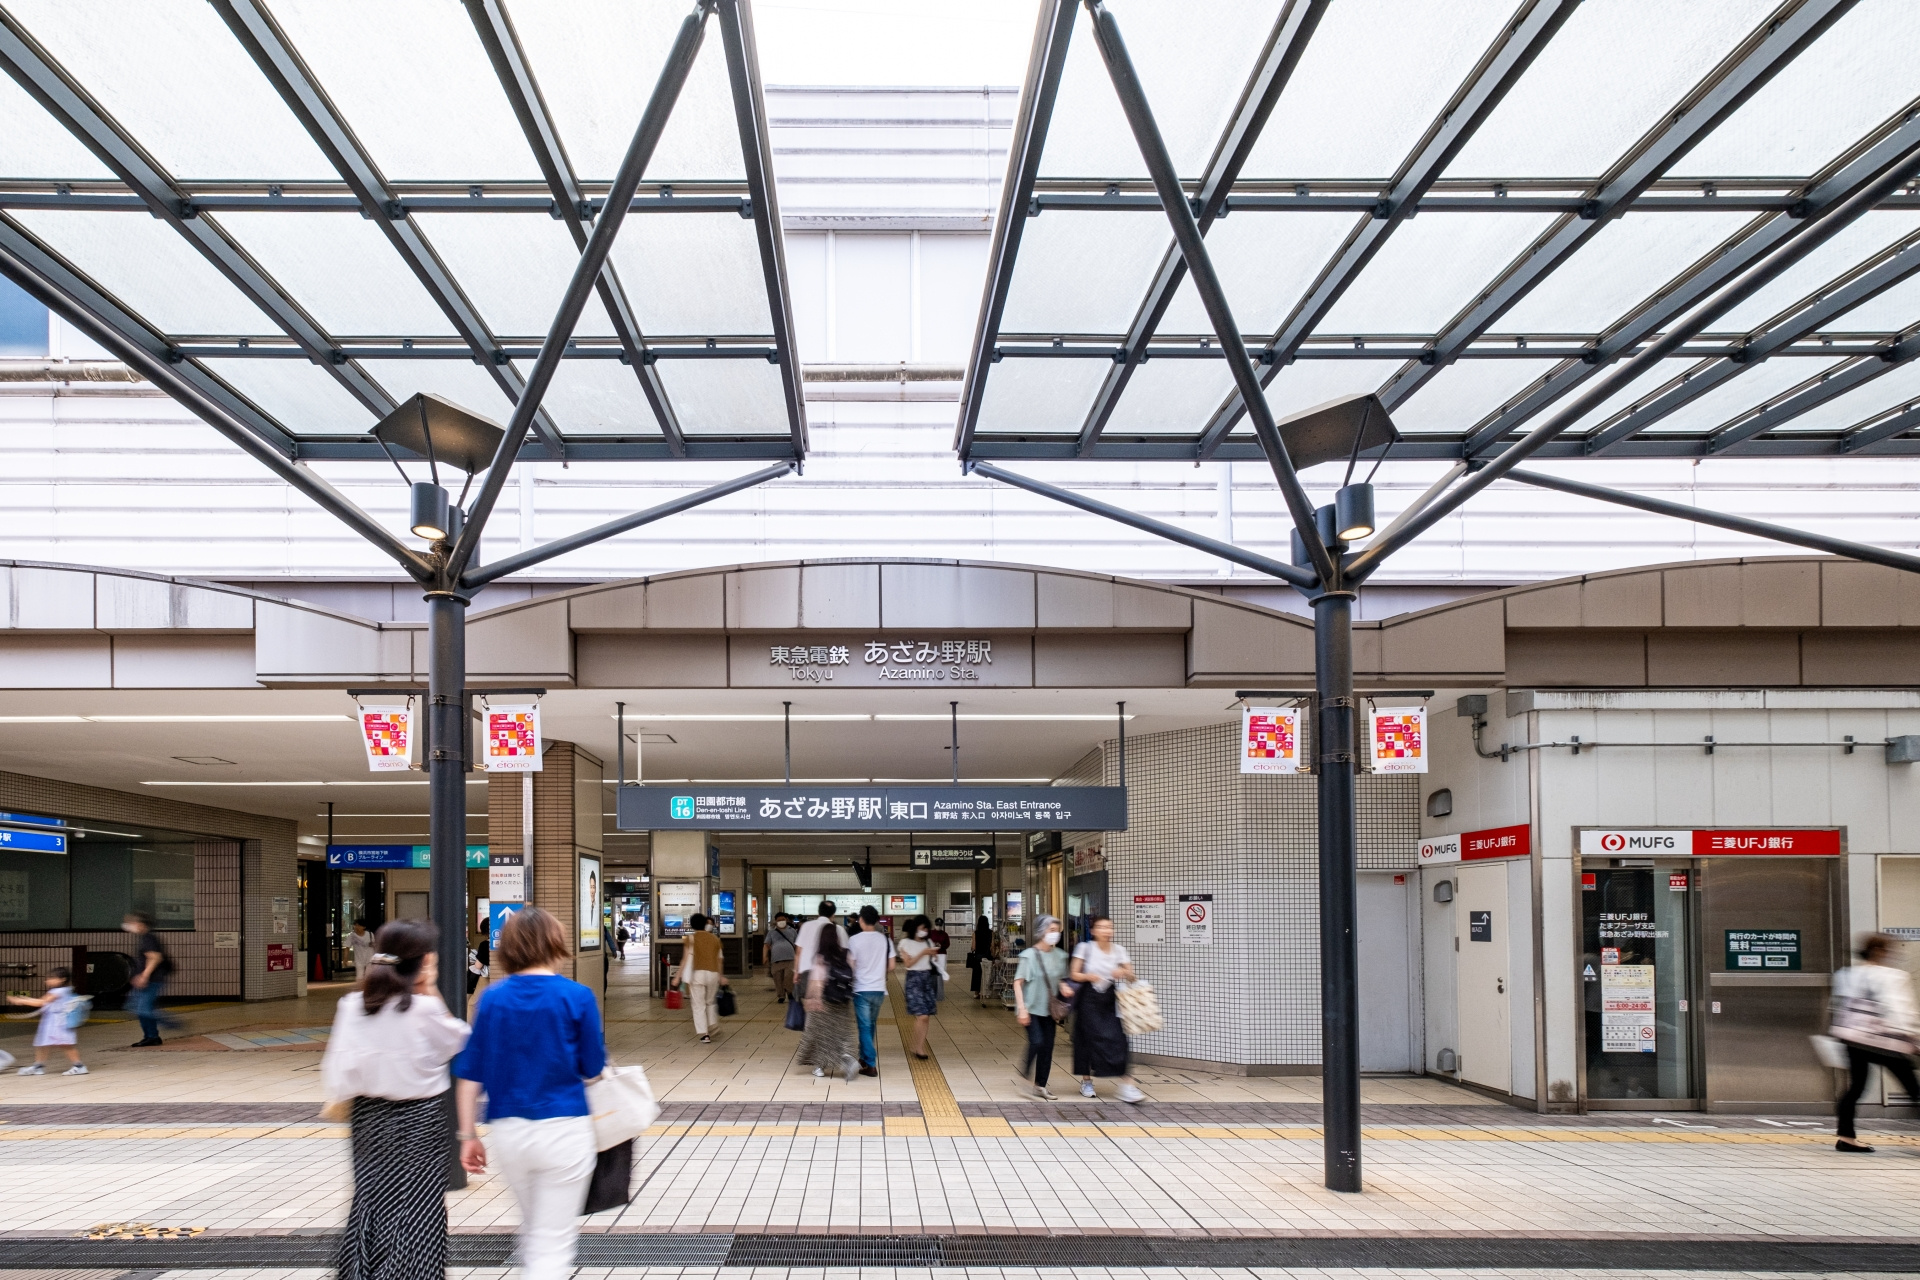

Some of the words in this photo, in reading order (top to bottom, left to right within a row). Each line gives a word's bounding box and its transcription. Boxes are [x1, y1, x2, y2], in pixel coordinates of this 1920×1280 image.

[770, 646, 850, 665] 東急電鉄
[864, 640, 992, 665] あざみ野駅
[788, 666, 833, 682] Tokyu
[879, 666, 945, 679] Azamino
[950, 666, 979, 679] Sta.
[696, 796, 746, 806] 田園都市線
[934, 801, 974, 810] Azamino
[976, 801, 995, 810] Sta.
[997, 801, 1017, 810] East
[1020, 801, 1062, 810] Entrance
[675, 806, 691, 817] 16
[759, 796, 882, 820] あざみ野駅
[889, 801, 928, 820] 東口
[991, 811, 1031, 820] 아자미노역
[1055, 811, 1072, 820] 입구
[56, 838, 61, 846] 3
[1469, 835, 1516, 851] 三菱UFJ銀行
[1629, 837, 1675, 849] MUFG
[1711, 837, 1794, 849] 三菱UFJ銀行
[1434, 843, 1457, 855] MUFG
[347, 850, 354, 861] B
[1730, 941, 1750, 950] 無料
